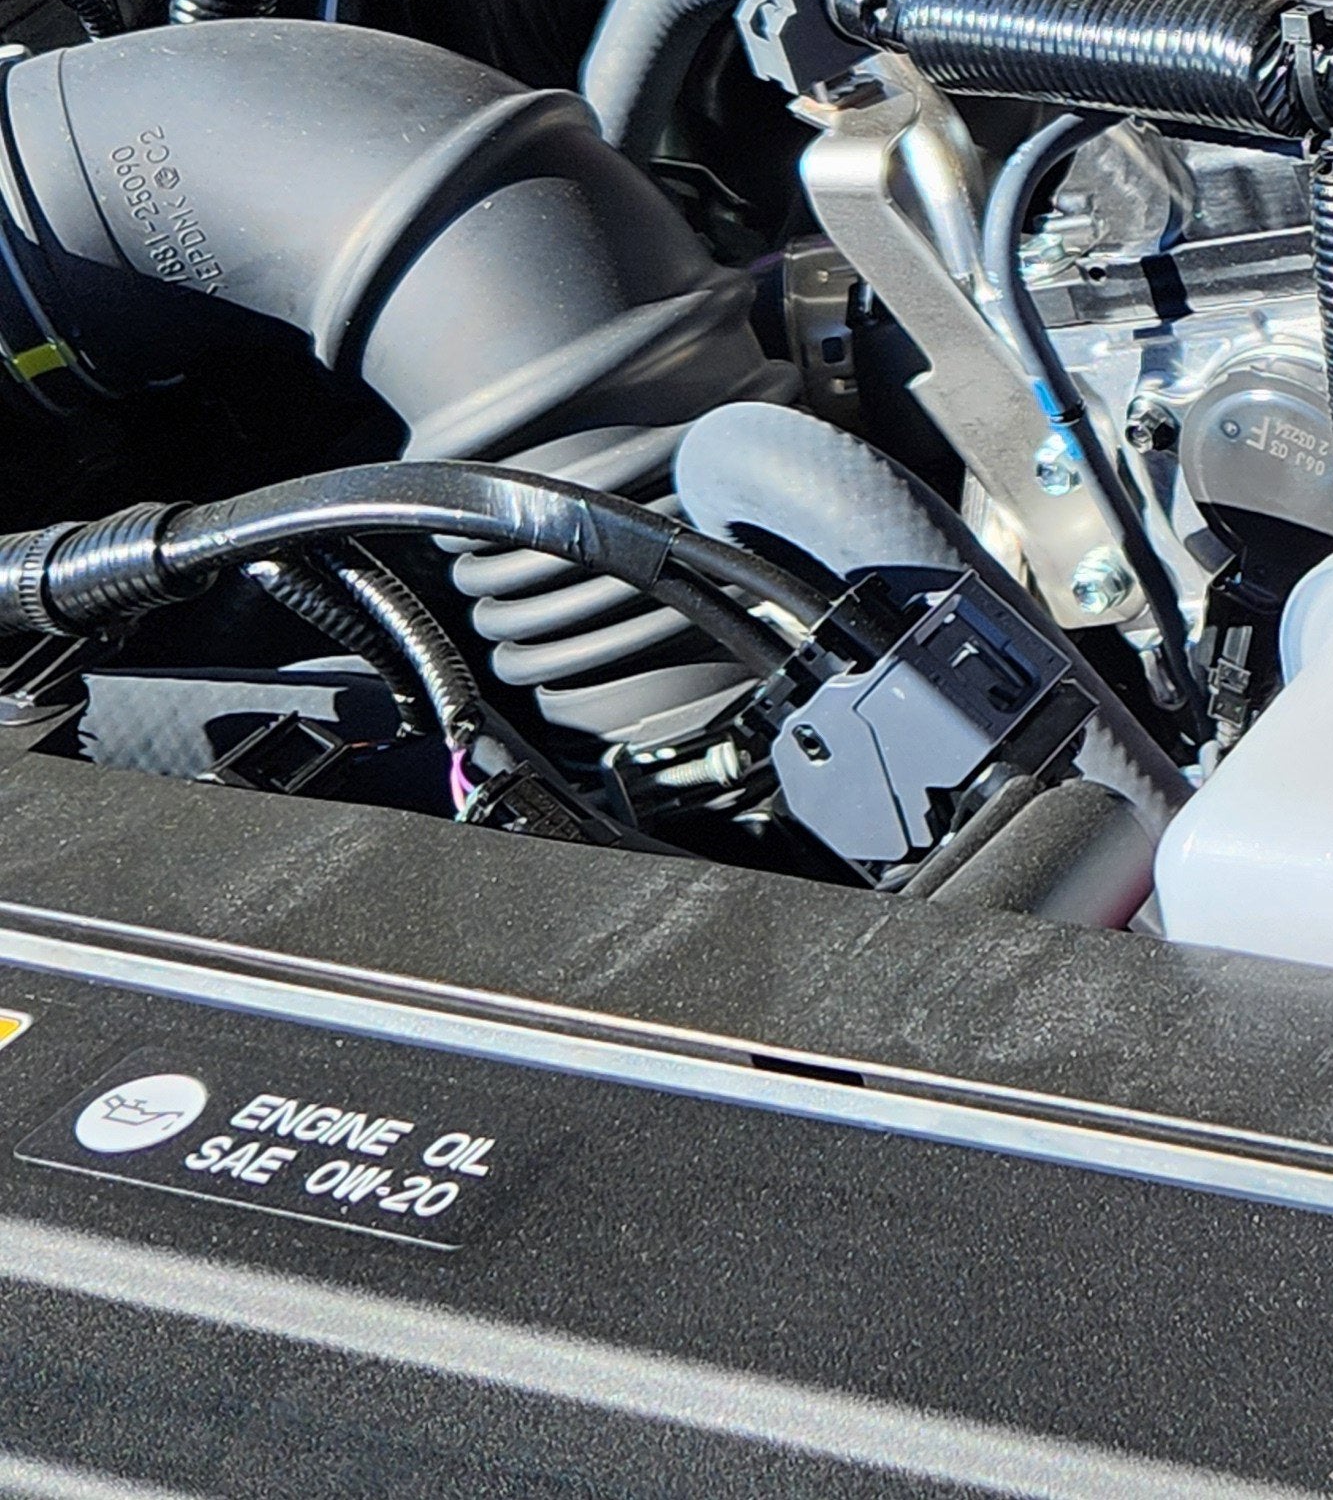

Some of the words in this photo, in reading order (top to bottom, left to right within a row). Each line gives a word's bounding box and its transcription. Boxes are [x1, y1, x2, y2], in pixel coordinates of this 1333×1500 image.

[1245, 416, 1270, 451] F
[229, 1093, 415, 1157] ENGINE
[421, 1131, 496, 1177] OIL
[184, 1136, 299, 1185] SAE
[304, 1160, 460, 1218] 0W-20
